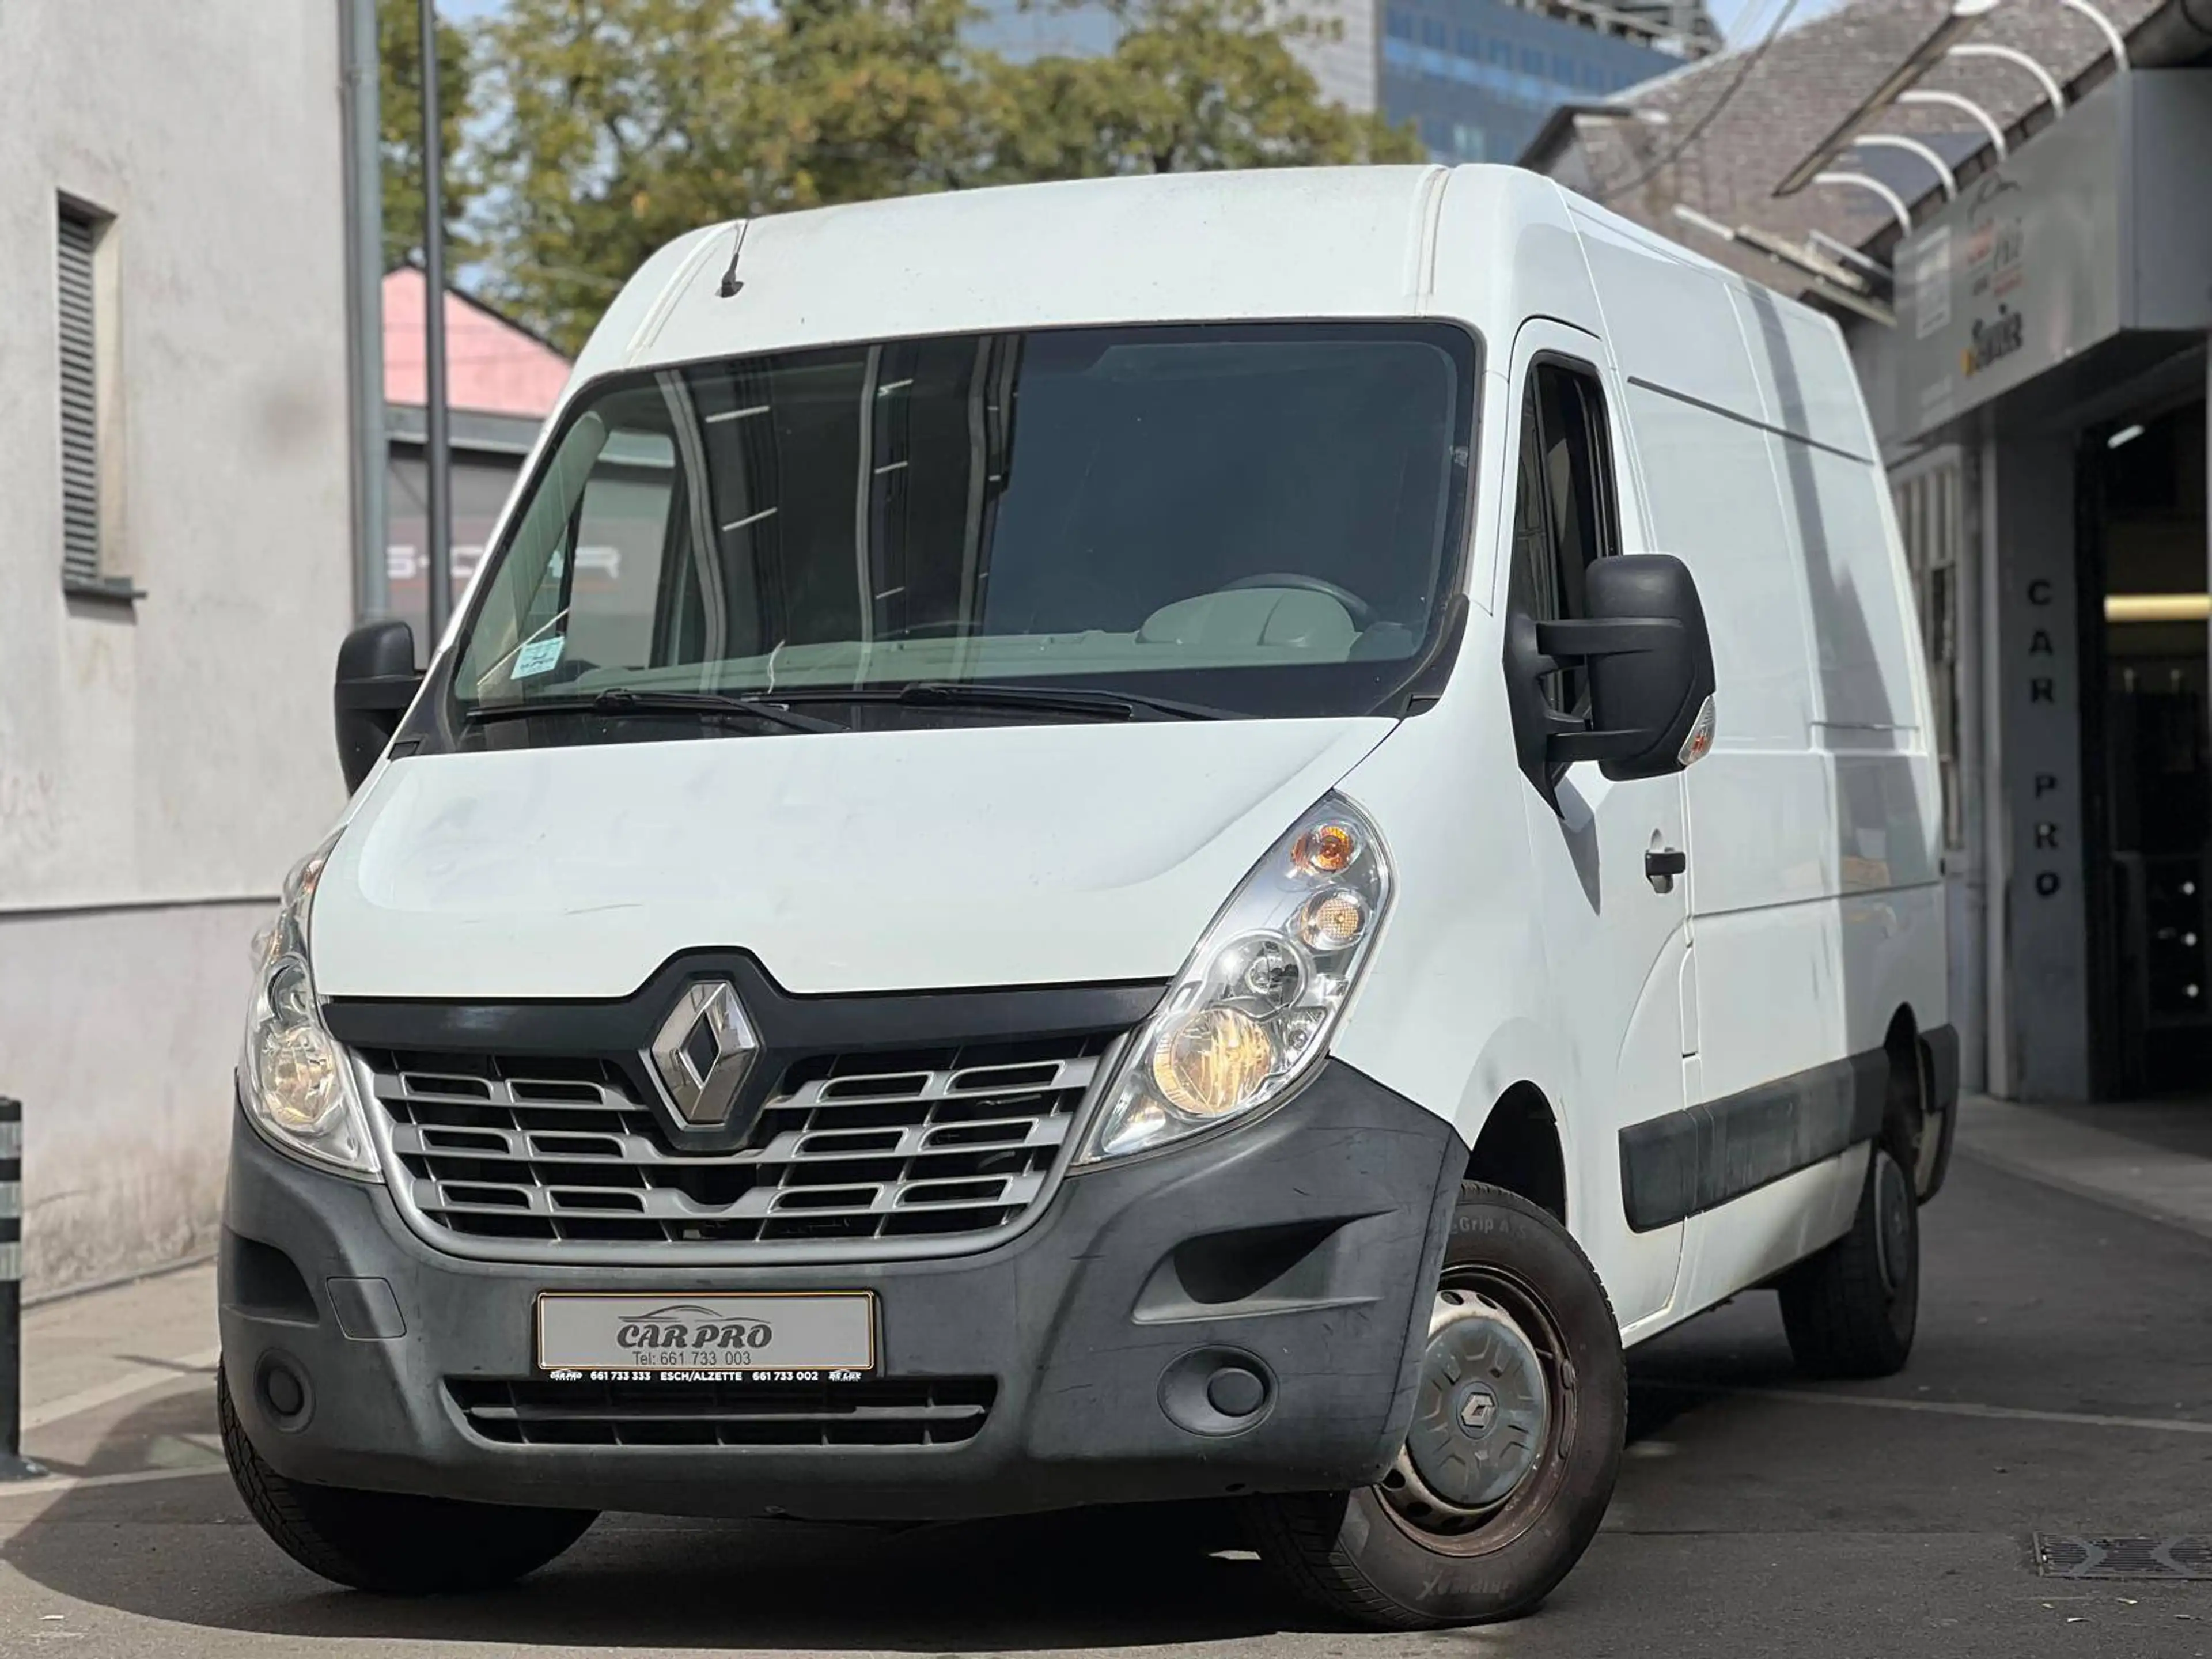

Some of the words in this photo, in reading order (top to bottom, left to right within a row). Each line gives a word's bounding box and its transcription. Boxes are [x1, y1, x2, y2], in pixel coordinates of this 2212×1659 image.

[2027, 579, 2055, 703] CAR
[2035, 773, 2061, 897] PRO
[616, 1324, 688, 1349] CAR
[691, 1324, 772, 1349] PRO
[632, 1351, 656, 1366] Tel:
[660, 1351, 684, 1366] 661
[691, 1351, 717, 1366] 733
[725, 1351, 751, 1366] 003
[590, 1371, 608, 1381] 661
[611, 1371, 630, 1381] 733
[631, 1371, 651, 1381] 333
[660, 1371, 743, 1382] ESCH/ALZETTE
[752, 1371, 771, 1381] 661
[774, 1371, 794, 1381] 733
[796, 1371, 819, 1381] 002
